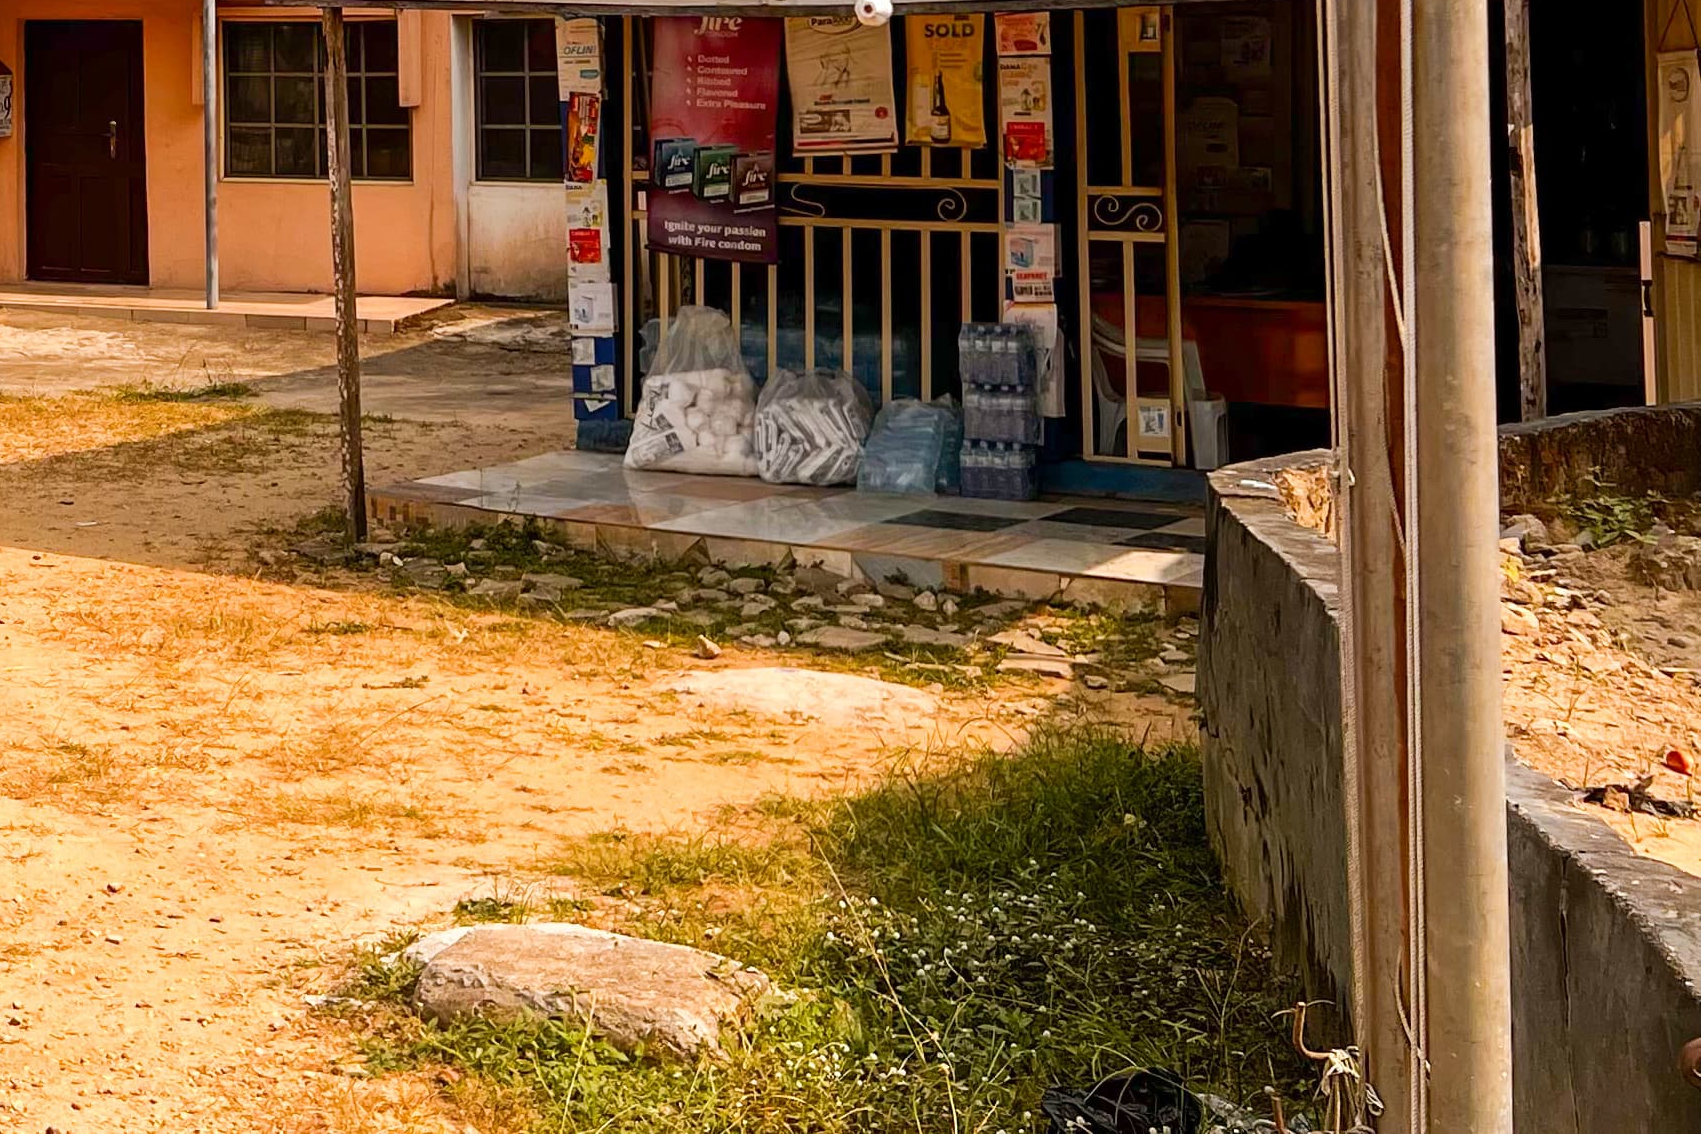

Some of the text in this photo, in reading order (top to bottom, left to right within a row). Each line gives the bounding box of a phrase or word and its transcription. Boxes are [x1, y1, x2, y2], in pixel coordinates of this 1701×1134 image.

[924, 23, 975, 38] SOLD
[667, 154, 691, 170] fire
[706, 163, 730, 179] fire
[742, 170, 767, 187] fire
[664, 220, 766, 237] Ignite your passion
[668, 235, 762, 251] with Fire condom
